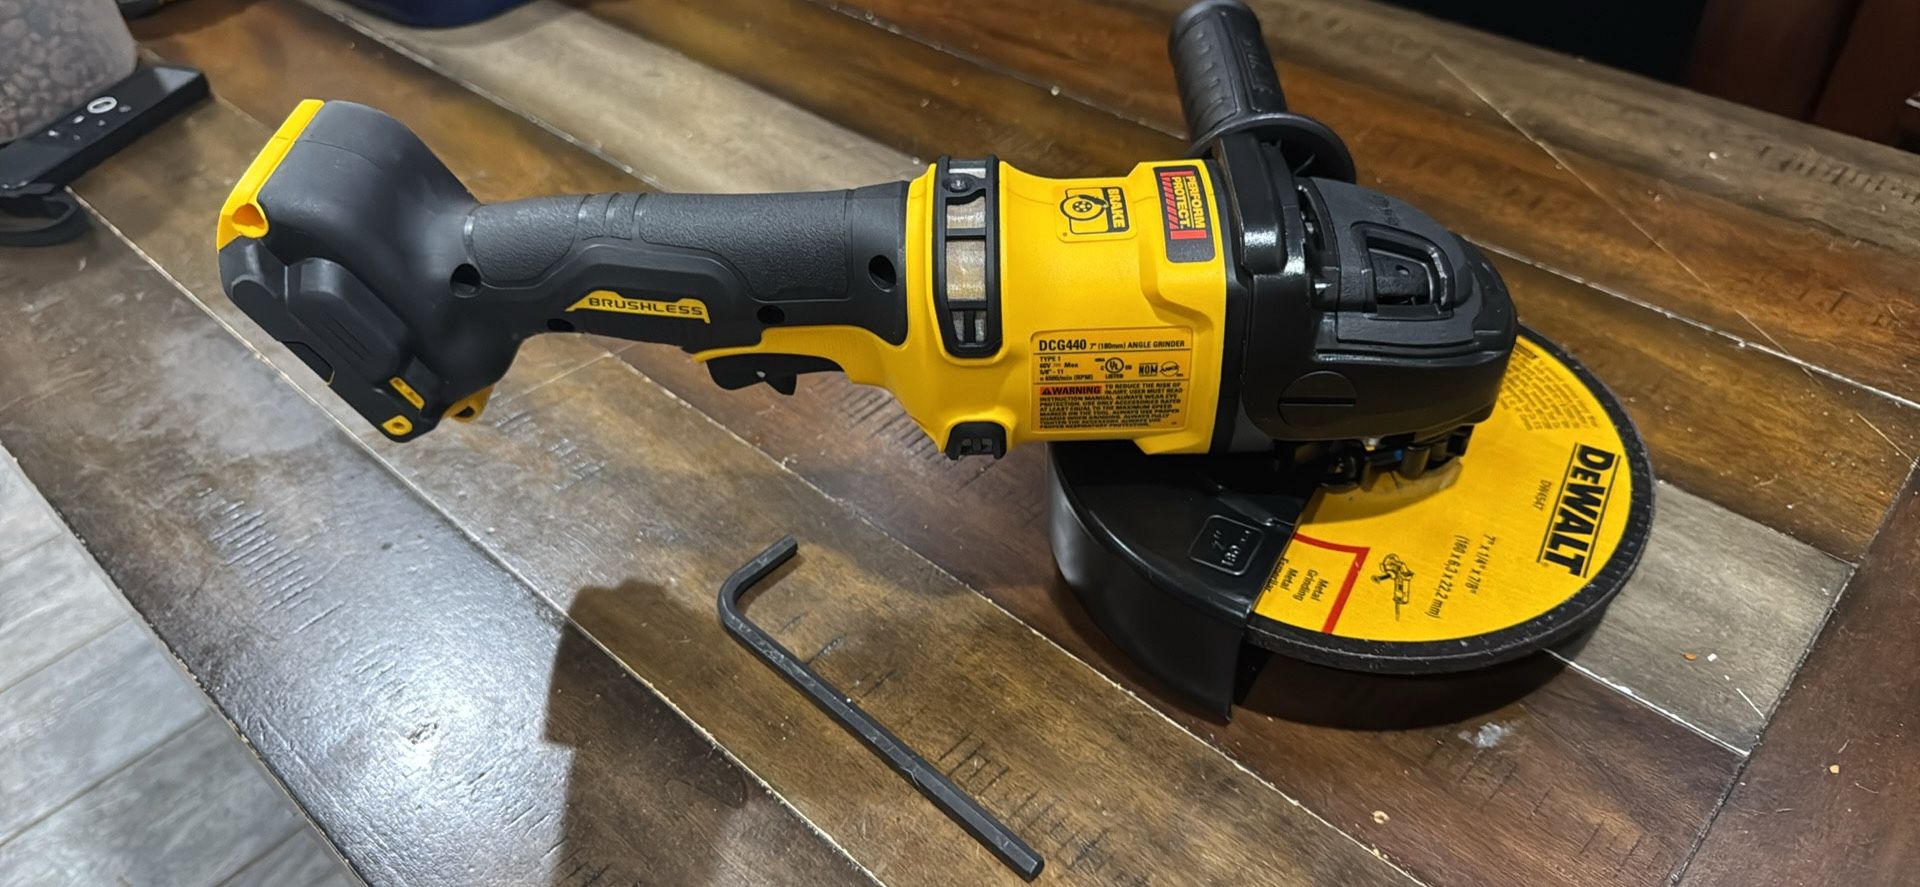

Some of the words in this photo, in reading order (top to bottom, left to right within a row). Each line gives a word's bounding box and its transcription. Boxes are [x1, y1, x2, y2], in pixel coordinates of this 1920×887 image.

[1106, 188, 1126, 229] BRAKE
[1171, 176, 1191, 230] PROTECT.
[1186, 175, 1206, 229] PERFORM
[588, 297, 703, 316] BRUSHLESS
[1039, 339, 1087, 351] DCG440
[1128, 341, 1151, 349] ANGLE
[1153, 340, 1185, 348] GRINDER
[1139, 364, 1158, 374] NOM
[1052, 386, 1101, 395] WARNING
[1544, 444, 1616, 578] DEWALT
[1453, 535, 1470, 554] (180
[1483, 534, 1496, 545] 7"
[1475, 552, 1489, 569] 1/4"
[1280, 568, 1298, 591] Metal
[1292, 569, 1318, 602] Grinding
[1311, 577, 1329, 601] Metal
[1465, 576, 1481, 594] 7/8"
[1424, 599, 1443, 618] mm)
